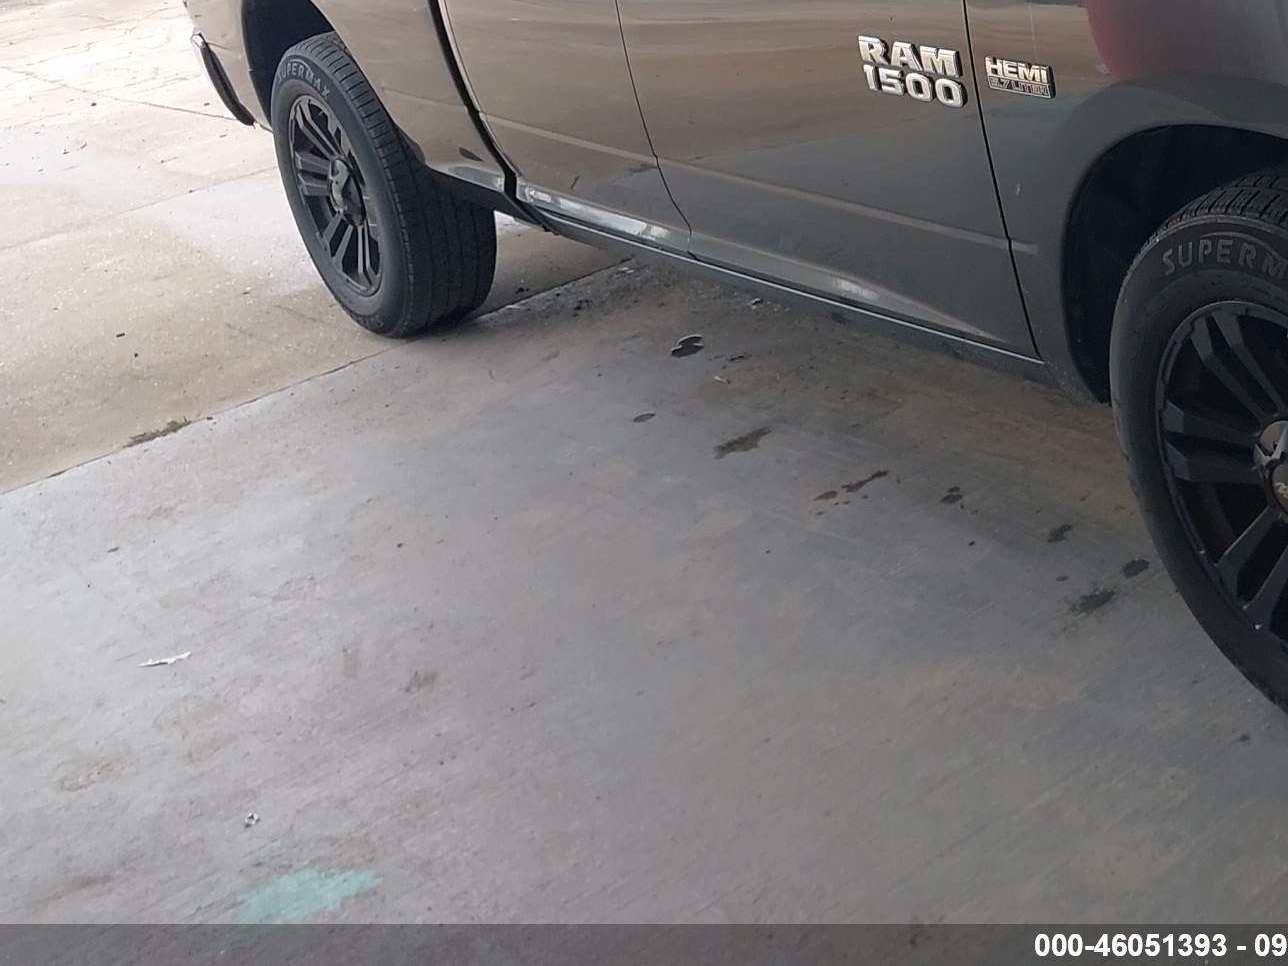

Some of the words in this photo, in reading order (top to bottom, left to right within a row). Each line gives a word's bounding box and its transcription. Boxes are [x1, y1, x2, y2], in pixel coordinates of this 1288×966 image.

[858, 35, 962, 79] RAM
[985, 56, 1048, 84] HEMI
[863, 64, 966, 108] 1500
